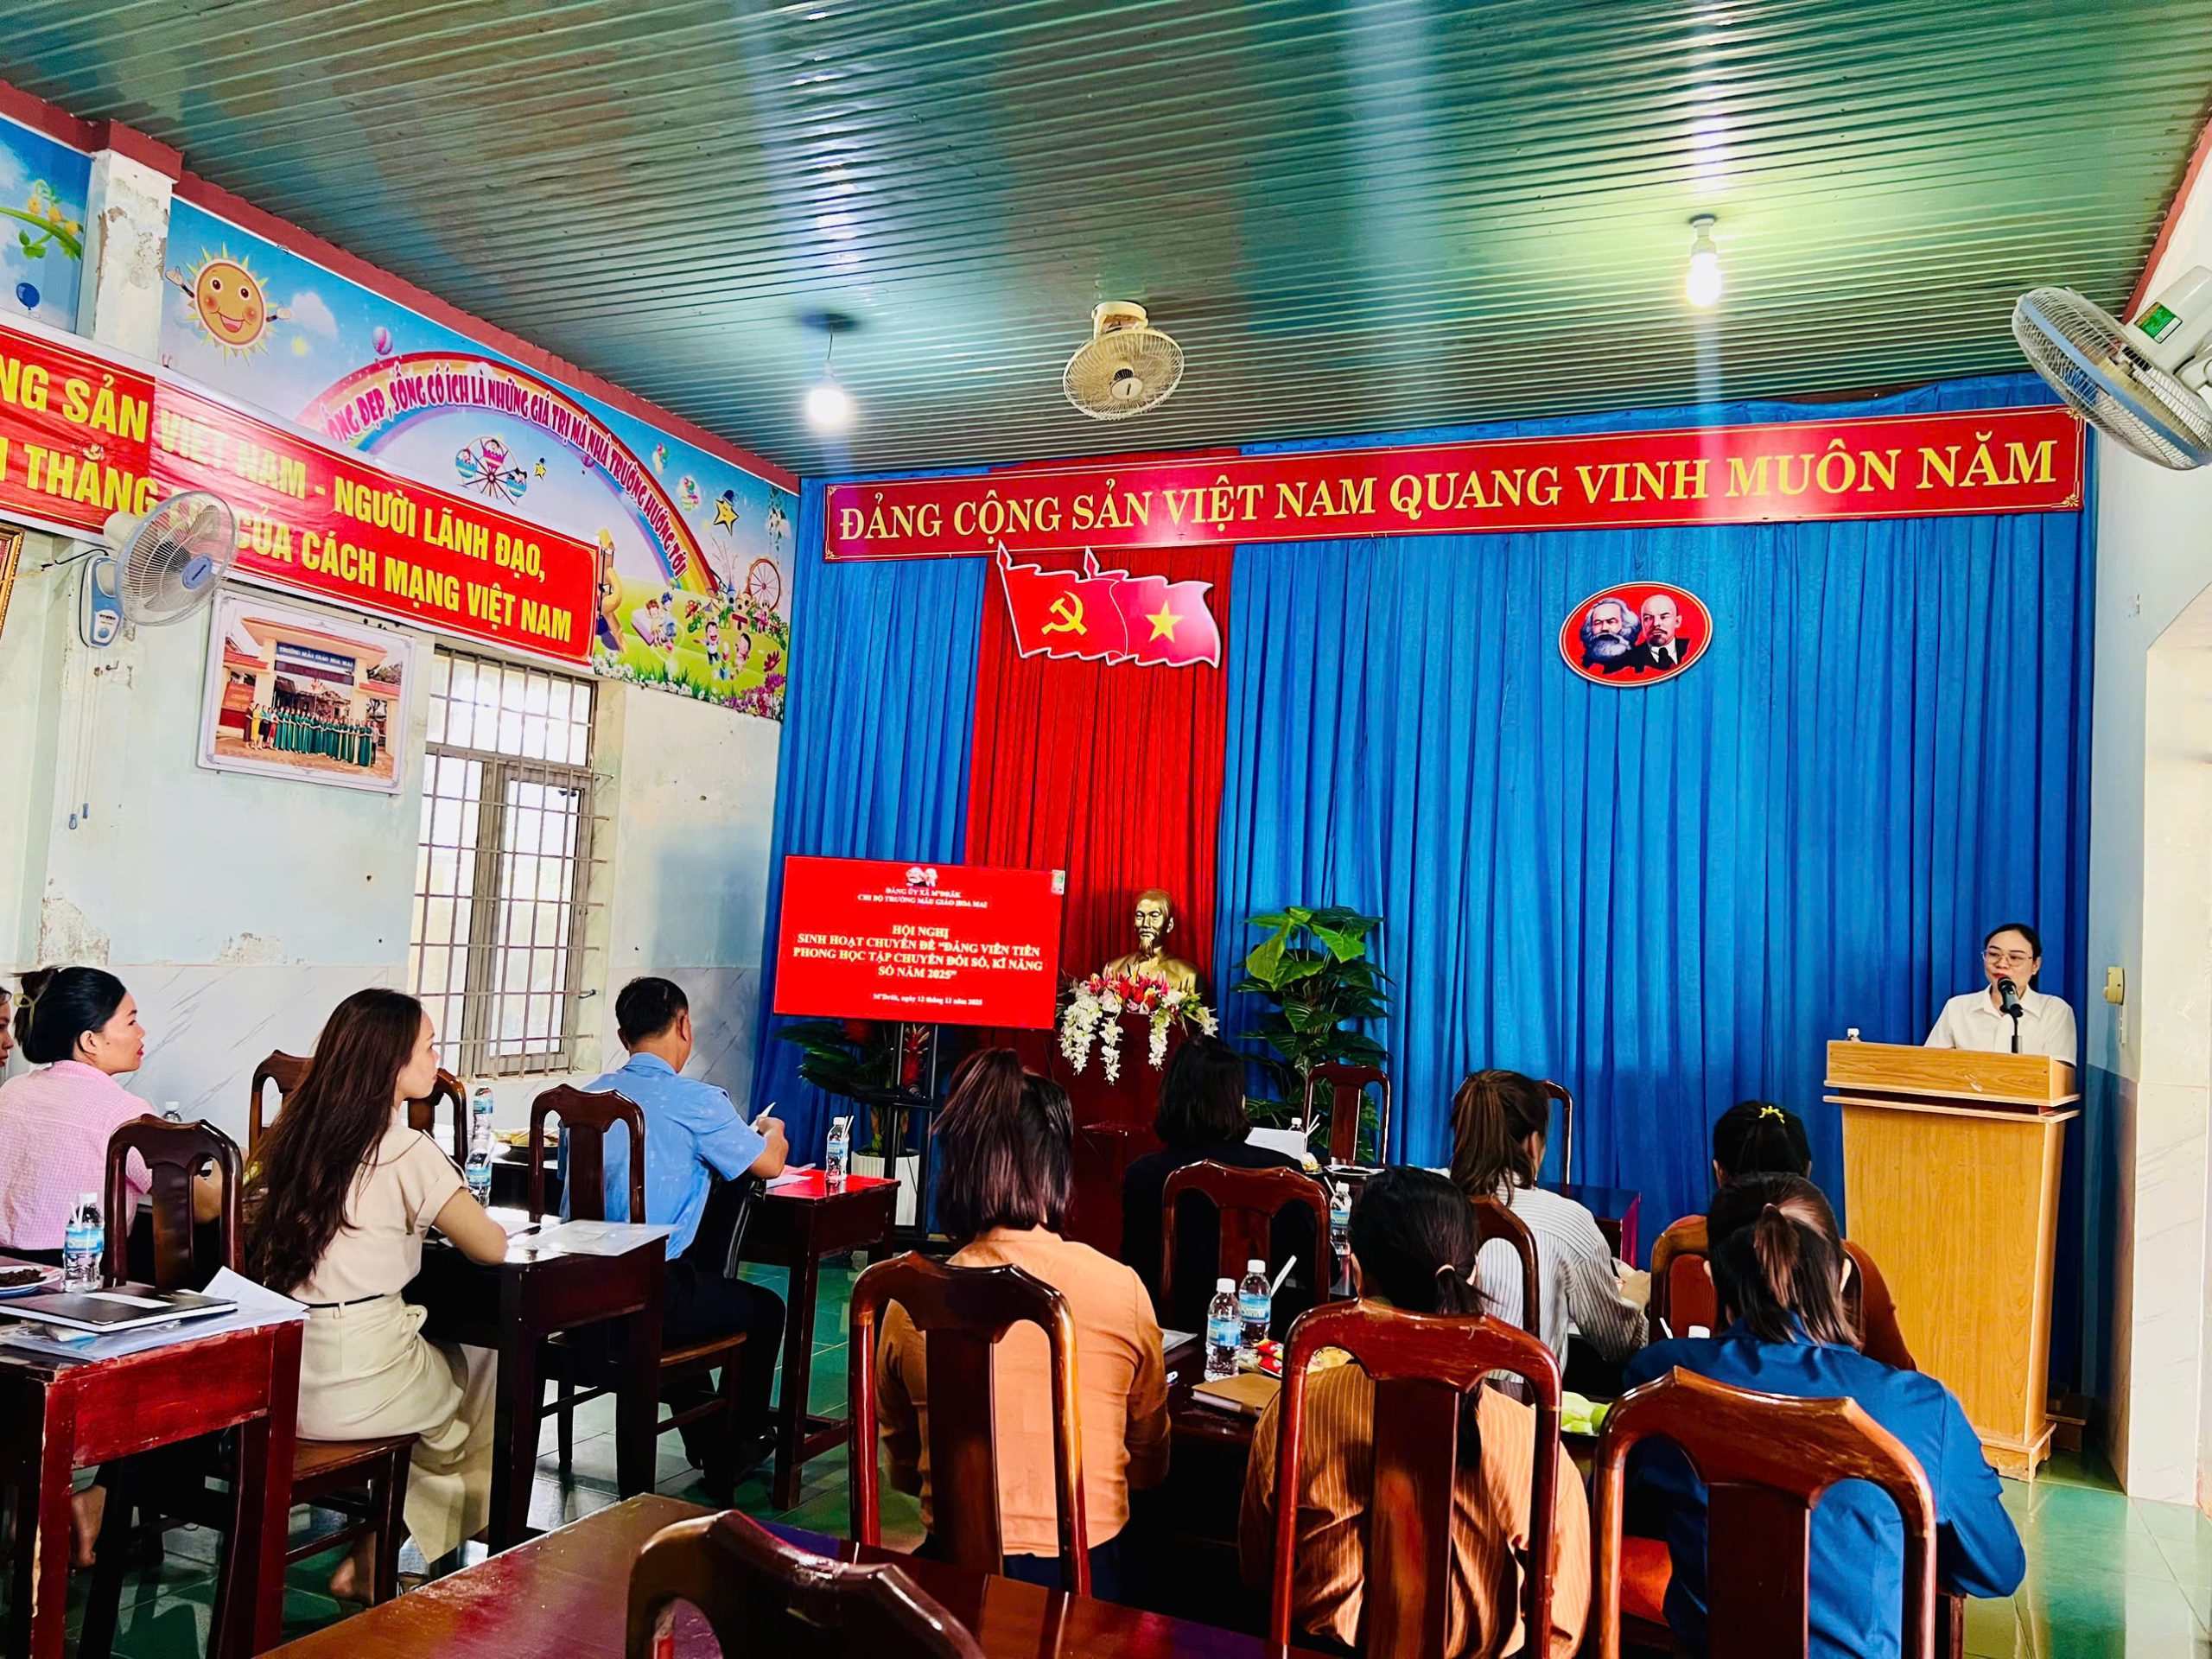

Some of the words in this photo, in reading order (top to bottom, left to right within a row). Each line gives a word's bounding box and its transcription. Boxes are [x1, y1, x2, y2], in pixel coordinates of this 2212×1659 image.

[62, 374, 149, 444] SẢN
[159, 408, 228, 472] VIỆT
[238, 439, 307, 500] NAM
[334, 476, 416, 537] NGƯỜI
[423, 508, 488, 562] LÃNH
[494, 531, 545, 584] ĐẠO,
[389, 365, 425, 410] SỐNG
[427, 366, 444, 404] CÓ
[447, 366, 468, 404] ÍCH
[471, 369, 486, 405] LÀ
[488, 377, 528, 418] NHỮNG
[531, 393, 550, 426] GIÁ
[552, 404, 571, 444] TRỊ
[570, 416, 588, 449] MÀ
[587, 429, 610, 467] NHÀ
[609, 448, 647, 506] TRƯỜNG
[644, 493, 674, 551] HƯỚNG
[668, 542, 686, 577] TỚI
[840, 492, 943, 540] ĐẢNG
[954, 490, 1062, 544] CỘNG
[1071, 479, 1151, 530] SẢN
[1162, 474, 1263, 531] VIỆT
[1274, 477, 1376, 518] NAM
[1389, 467, 1561, 520] QUANG
[1575, 460, 1709, 504] VINH
[1726, 438, 1900, 497] MUÔN
[1916, 431, 2057, 490] NĂM
[234, 504, 292, 563] CỦA
[302, 531, 376, 588] CÁCH
[385, 556, 459, 612] MẠNG
[467, 581, 515, 630] VIỆT
[520, 599, 572, 643] NAM
[936, 898, 954, 906] GIÁO
[893, 925, 915, 938] HỘI
[918, 926, 949, 939] NGHỊ
[798, 933, 827, 944] SINH
[830, 935, 864, 948] HOẠT
[867, 937, 917, 950] CHUYÊN
[919, 938, 936, 950] ĐỀ
[981, 942, 1009, 955] VIÊN
[1012, 944, 1040, 957] TIÊN
[793, 947, 836, 959] PHONG
[839, 950, 866, 962] HỌC
[868, 950, 892, 963] TẬP
[894, 952, 944, 965] CHUYỂN
[946, 954, 969, 966] ĐỔI
[1009, 958, 1043, 971] NĂNG
[878, 964, 895, 976] SỐ
[897, 966, 925, 978] NĂM
